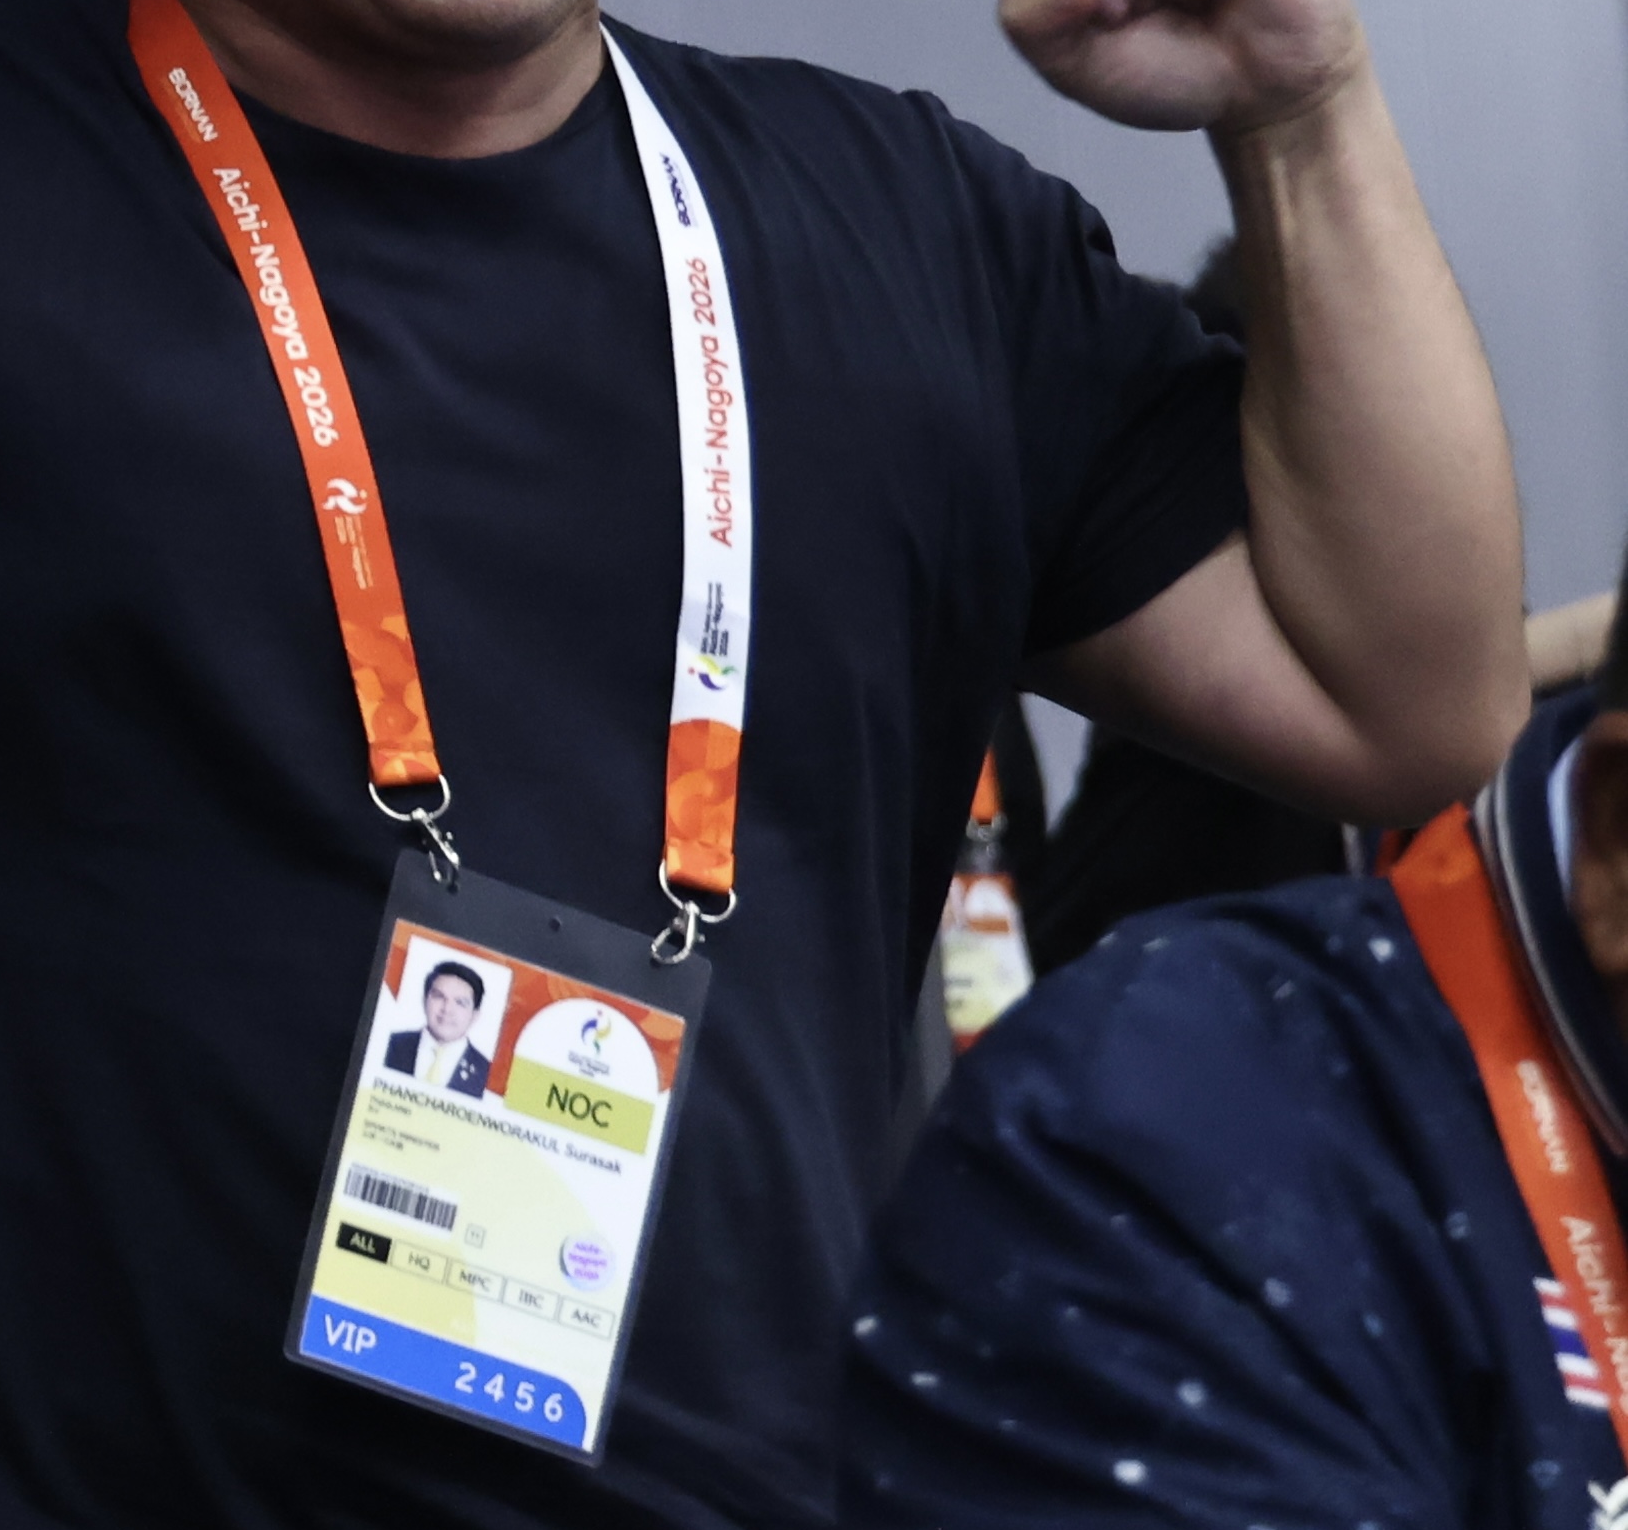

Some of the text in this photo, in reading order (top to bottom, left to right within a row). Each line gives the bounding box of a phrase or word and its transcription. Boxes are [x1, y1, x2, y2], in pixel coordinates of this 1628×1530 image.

[168, 67, 218, 142] BORNAN
[212, 168, 340, 448] Aichi-Nagoya 2026
[686, 257, 716, 327] 2026
[700, 334, 733, 548] Aichi-Nagoya
[546, 1082, 613, 1128] NOC
[564, 1142, 622, 1174] Surasak
[350, 1231, 376, 1254] ALL
[324, 1314, 377, 1354] VIP
